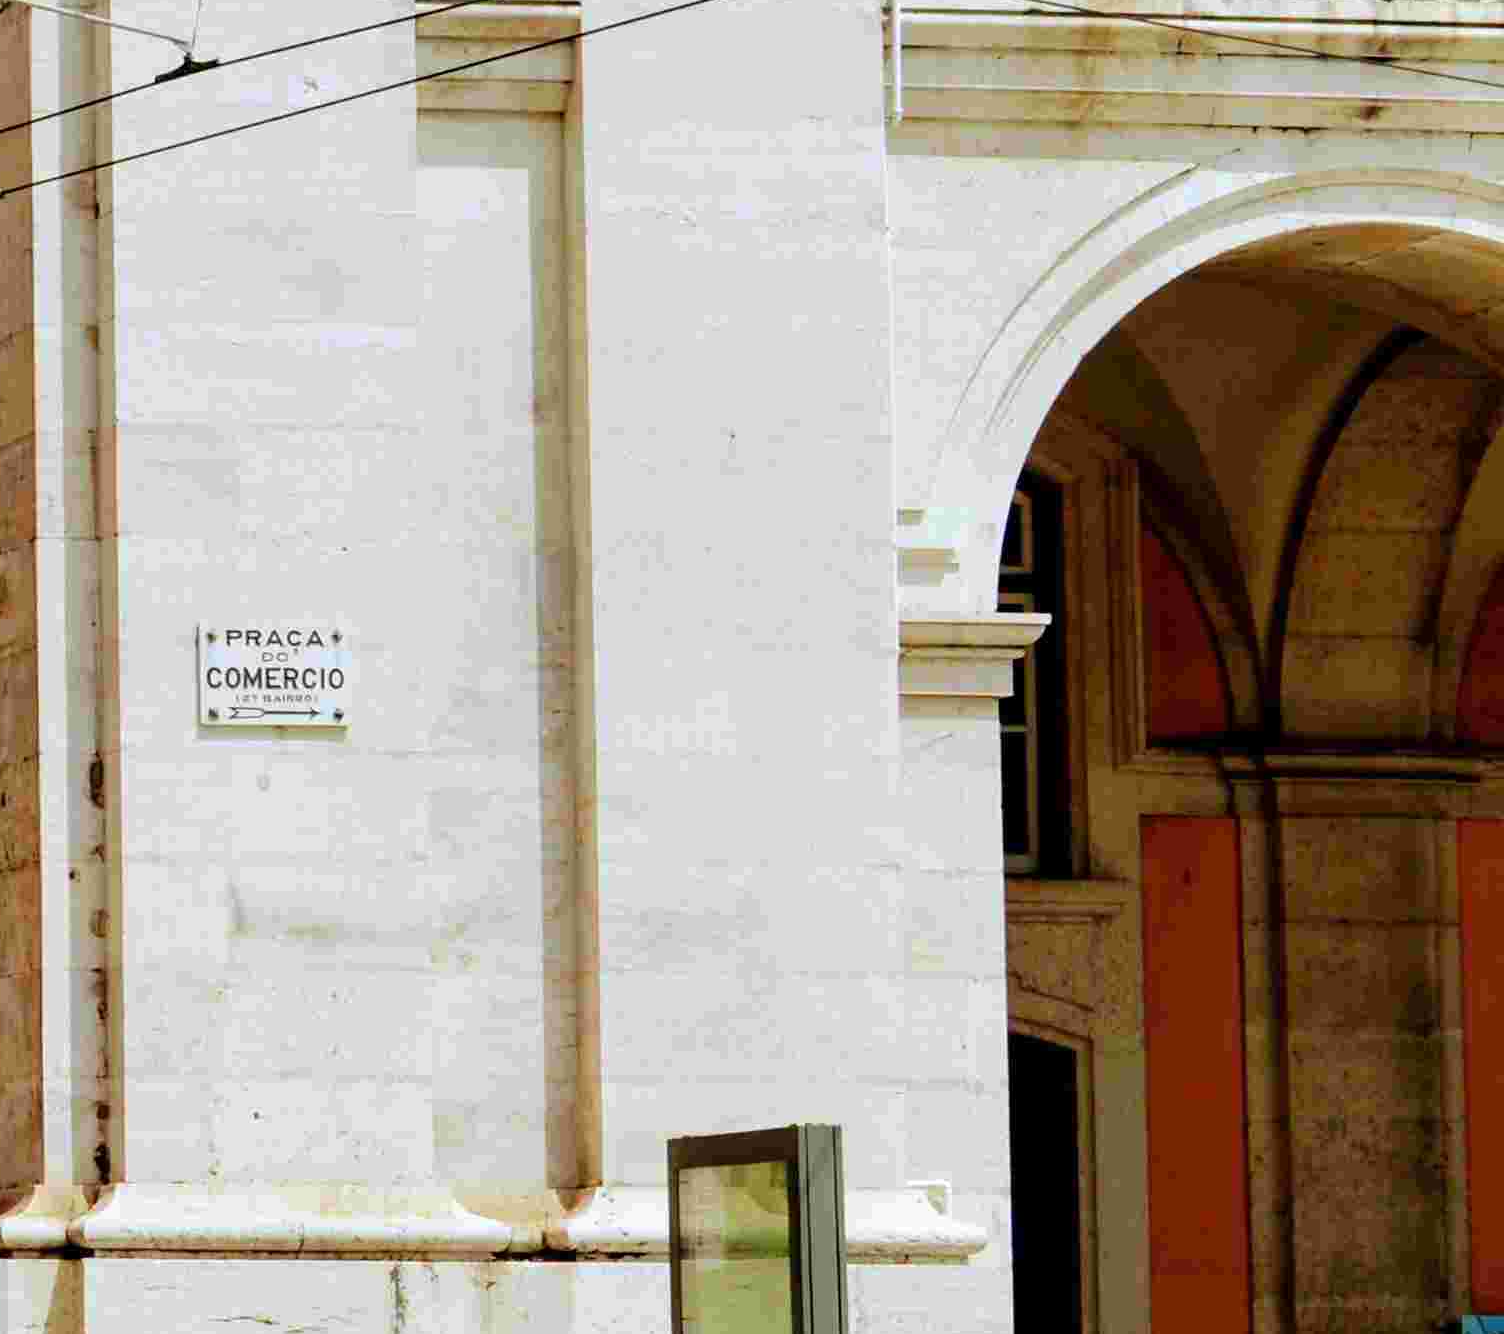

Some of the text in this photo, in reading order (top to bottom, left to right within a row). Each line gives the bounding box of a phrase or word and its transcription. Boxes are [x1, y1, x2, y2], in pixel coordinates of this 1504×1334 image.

[225, 629, 325, 655] PRAÇA
[261, 652, 289, 663] DO
[206, 666, 345, 690] COMERCIO
